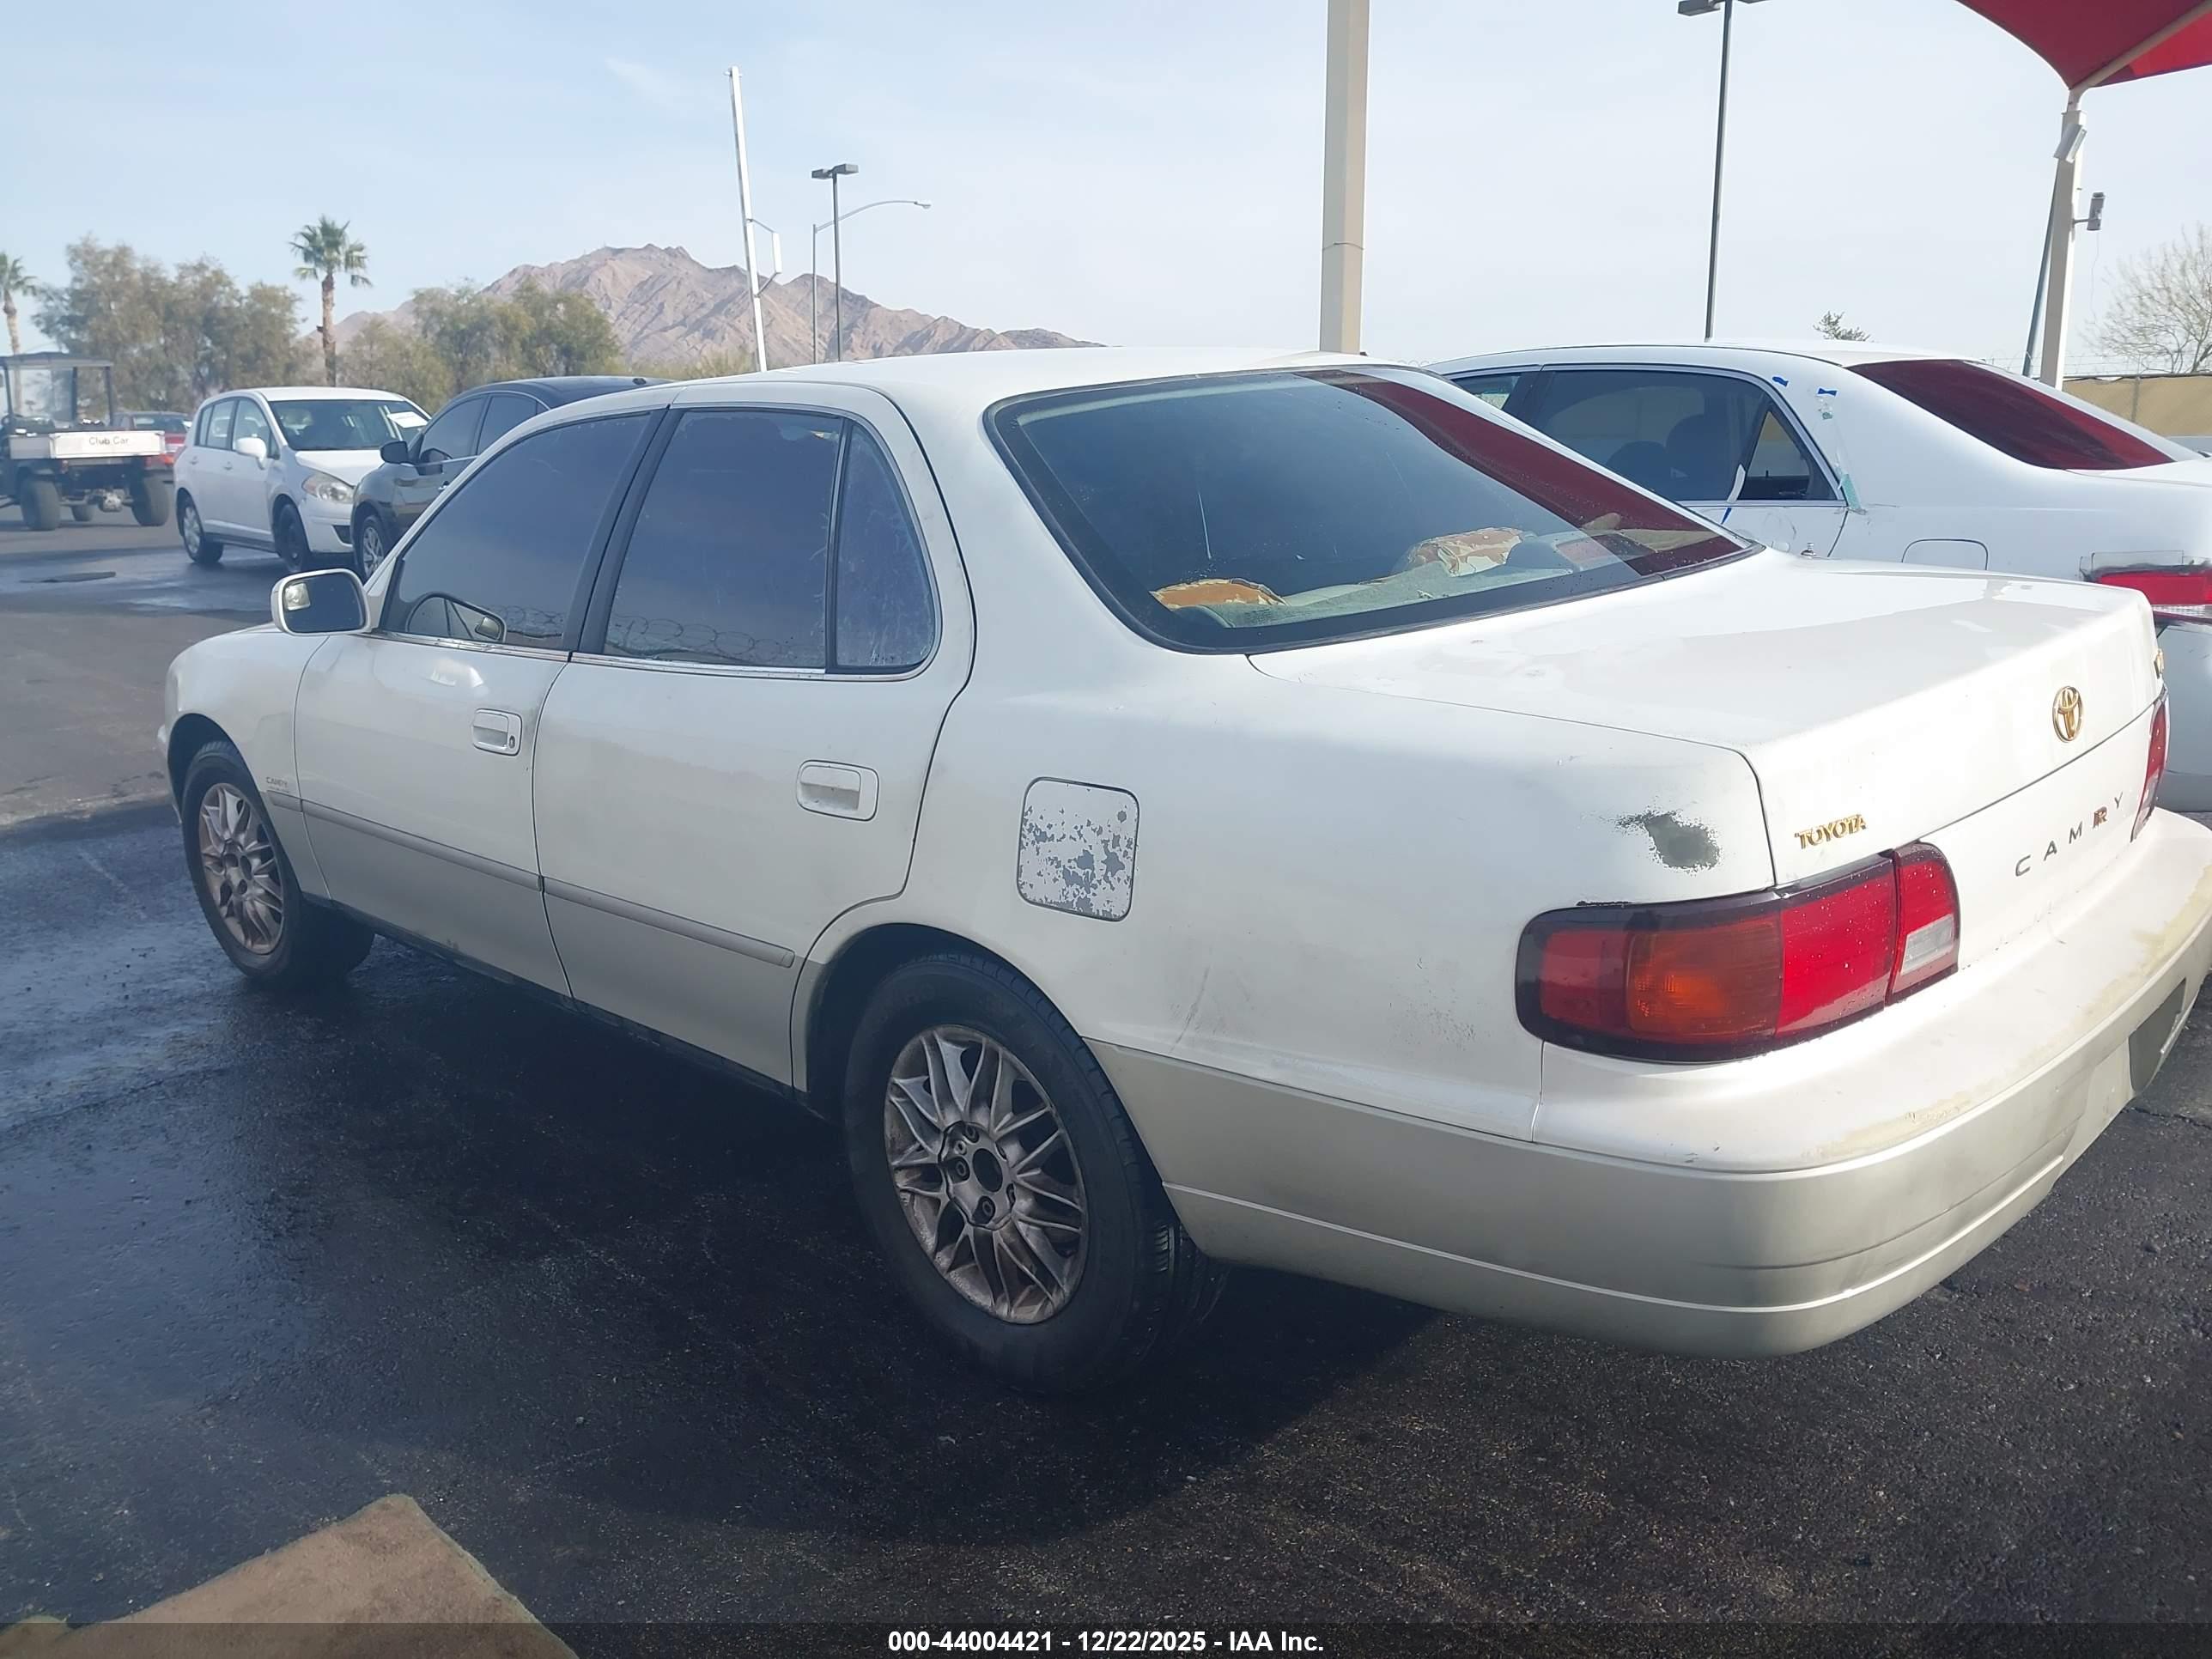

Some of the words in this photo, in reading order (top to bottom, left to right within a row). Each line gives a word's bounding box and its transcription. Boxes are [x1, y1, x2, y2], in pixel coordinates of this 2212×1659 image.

[88, 436, 111, 446] Club
[112, 435, 130, 445] Car
[1794, 813, 1867, 849] TOYOTA
[2014, 791, 2124, 877] CAMRY
